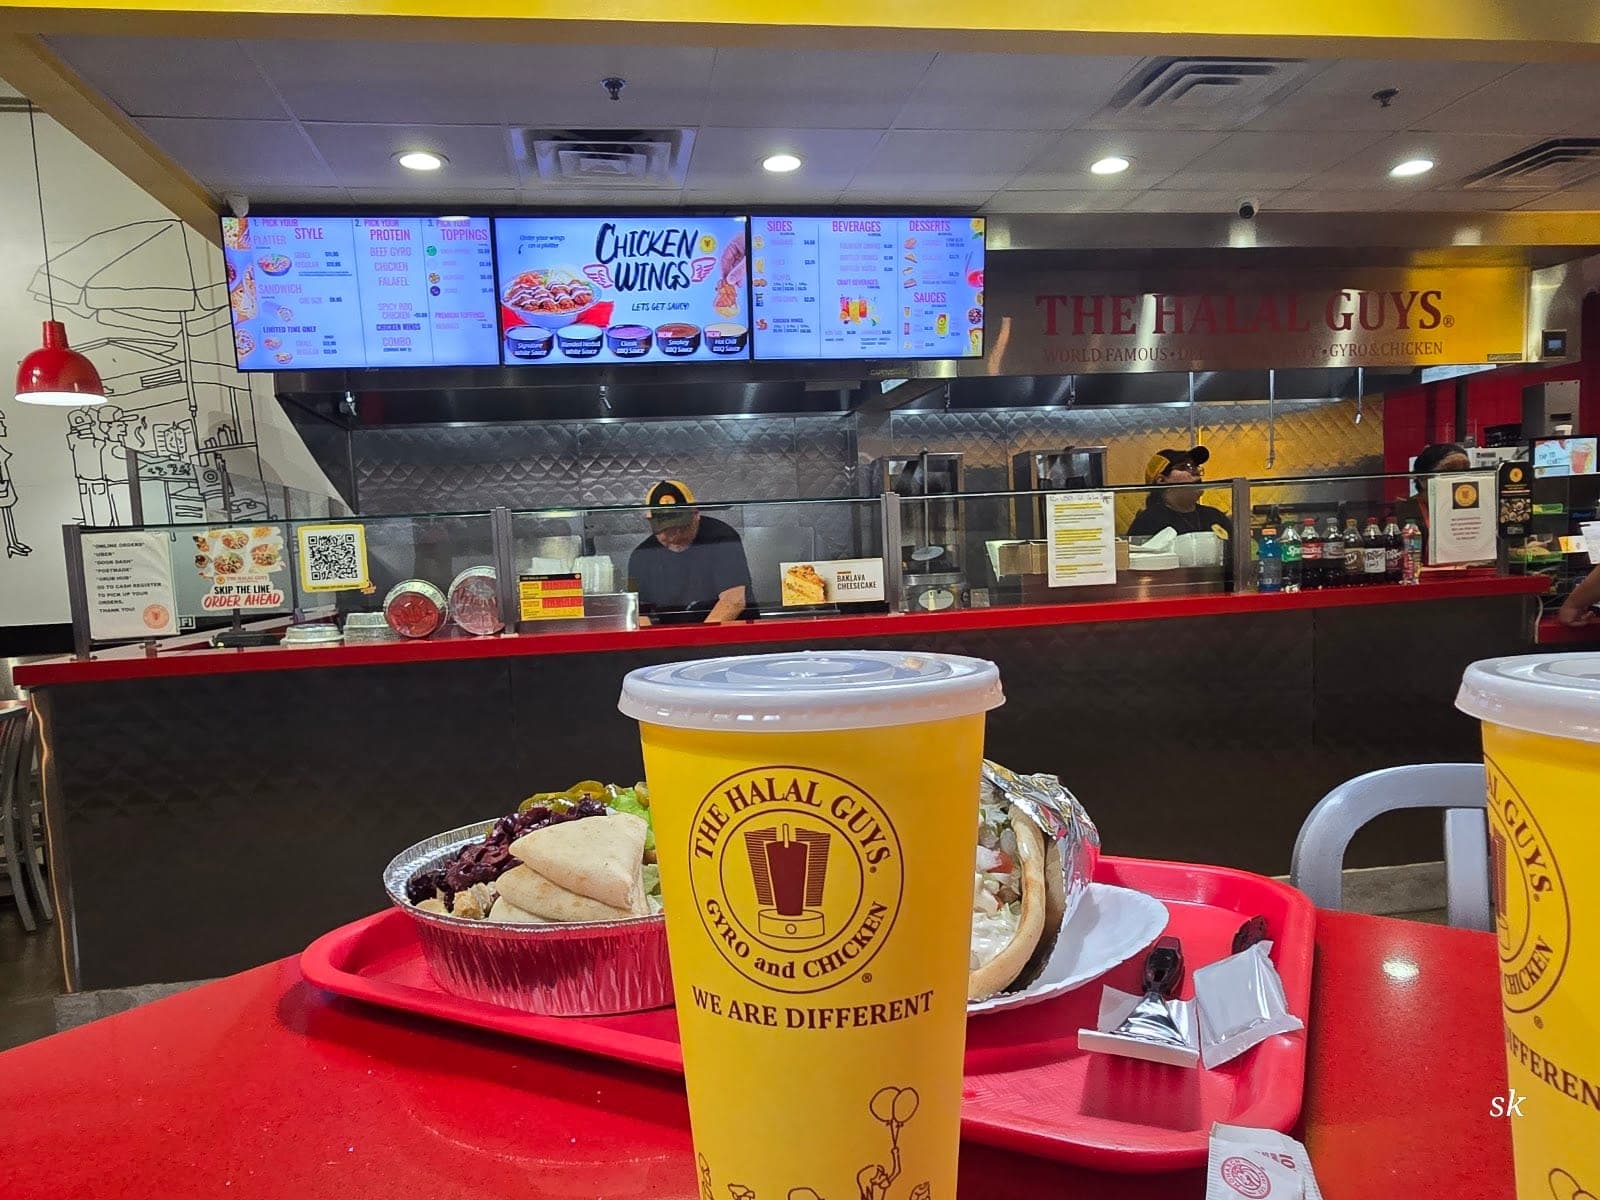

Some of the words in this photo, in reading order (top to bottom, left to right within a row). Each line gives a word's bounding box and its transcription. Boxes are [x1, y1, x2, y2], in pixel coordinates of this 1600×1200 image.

[767, 220, 792, 232] SIDES
[832, 220, 881, 232] BEVERAGES
[909, 220, 950, 231] DESSERTS
[295, 227, 324, 239] STYLE
[370, 229, 411, 240] PROTEIN
[440, 228, 488, 240] TOPPINGS
[595, 223, 699, 264] CHICKEN
[370, 247, 388, 256] BEEF
[391, 247, 411, 256] GYRO
[375, 262, 408, 271] CHICKEN
[379, 277, 409, 286] FALAFEL
[614, 260, 690, 292] WINGS
[258, 284, 302, 294] SANDWICH
[914, 292, 946, 303] SAUCES
[650, 302, 665, 311] GET
[1036, 294, 1137, 336] THE
[1153, 292, 1310, 335] HALAL
[383, 337, 411, 346] COMBO
[1045, 349, 1100, 363] WORLD
[1106, 347, 1167, 362] FAMOUS
[836, 574, 865, 582] BAKLAVA
[214, 585, 233, 595] SKIP
[236, 585, 252, 594] THE
[253, 584, 271, 594] LINE
[837, 581, 877, 590] CHEESECAKE
[204, 594, 241, 609] ORDER
[244, 593, 281, 606] AHEAD
[695, 803, 730, 860] THE
[724, 777, 823, 814] HALAL
[706, 898, 750, 958] GYRO
[754, 957, 796, 979] and
[802, 901, 888, 979] CHICKEN
[691, 985, 723, 1015] WE
[727, 1000, 778, 1027] ARE
[786, 990, 935, 1030] DIFFERENT
[1504, 1021, 1600, 1112] IFFEREN
